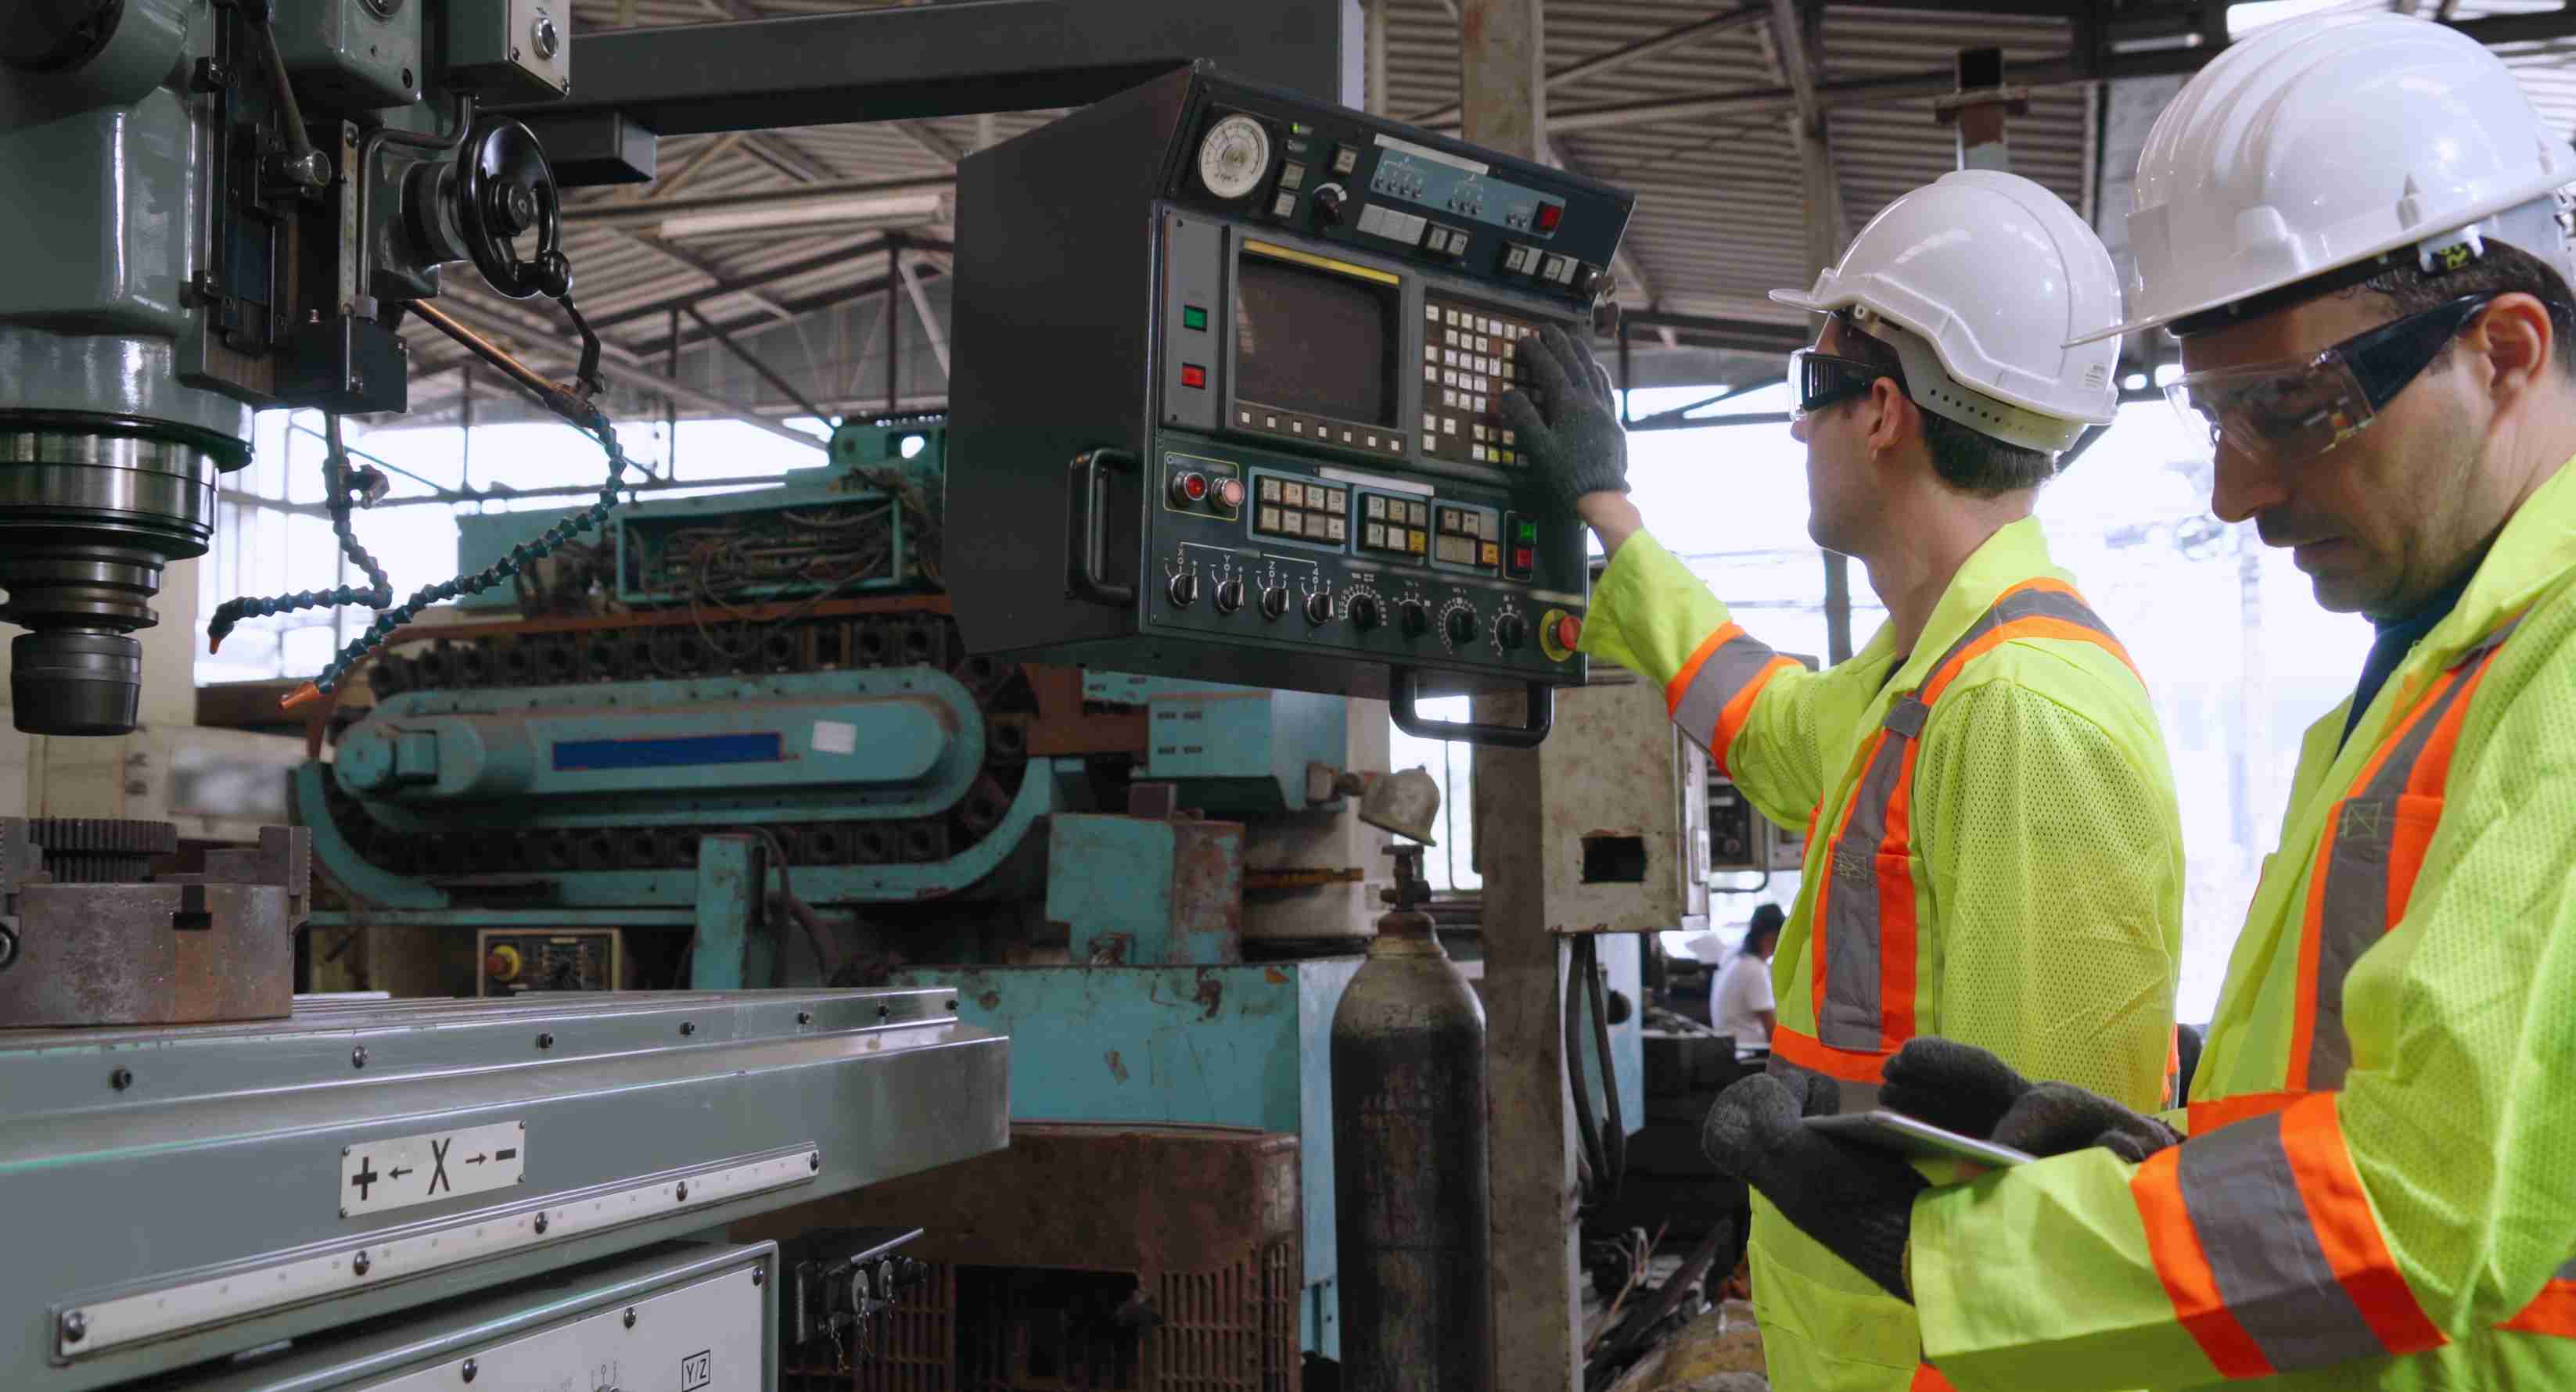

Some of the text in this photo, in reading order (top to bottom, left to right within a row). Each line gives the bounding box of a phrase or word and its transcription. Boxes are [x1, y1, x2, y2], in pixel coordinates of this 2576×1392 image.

[1269, 561, 1276, 569] Z
[428, 1138, 451, 1195] X
[686, 1358, 707, 1383] Y/Z
